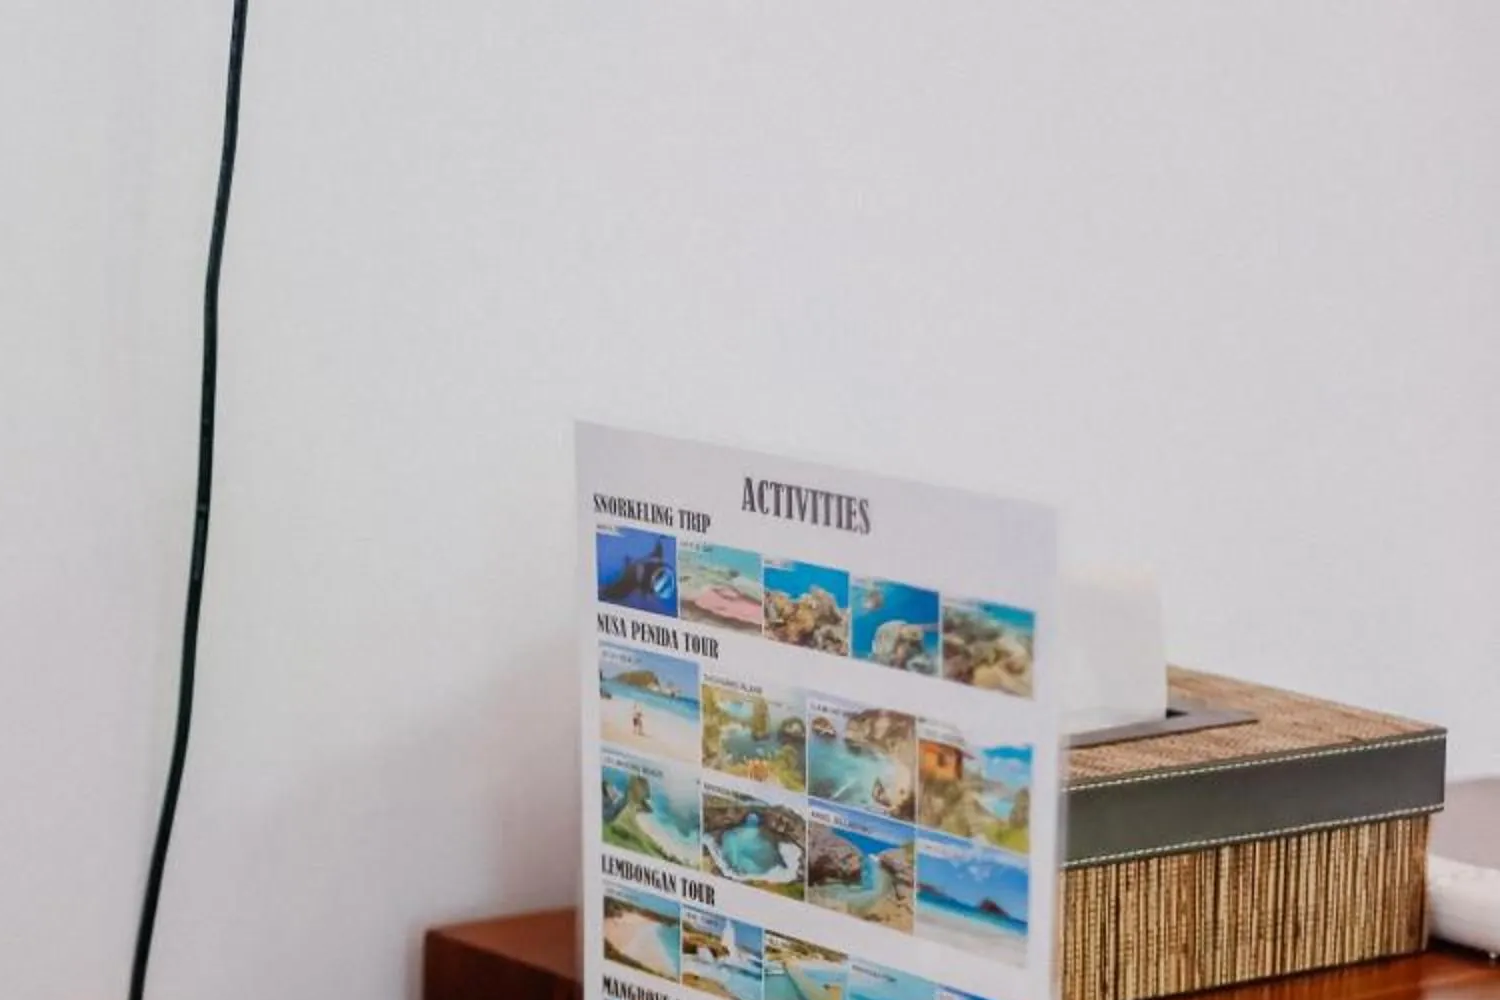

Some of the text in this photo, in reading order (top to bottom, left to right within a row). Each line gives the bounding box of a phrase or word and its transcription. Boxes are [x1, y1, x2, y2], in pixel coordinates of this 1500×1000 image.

[592, 493, 712, 534] SNORKELING TRIP
[741, 477, 871, 535] ACTIVITIES
[597, 613, 720, 660] NUSA PENIDA TOUR
[601, 853, 716, 907] LEMBONGAN TOUR
